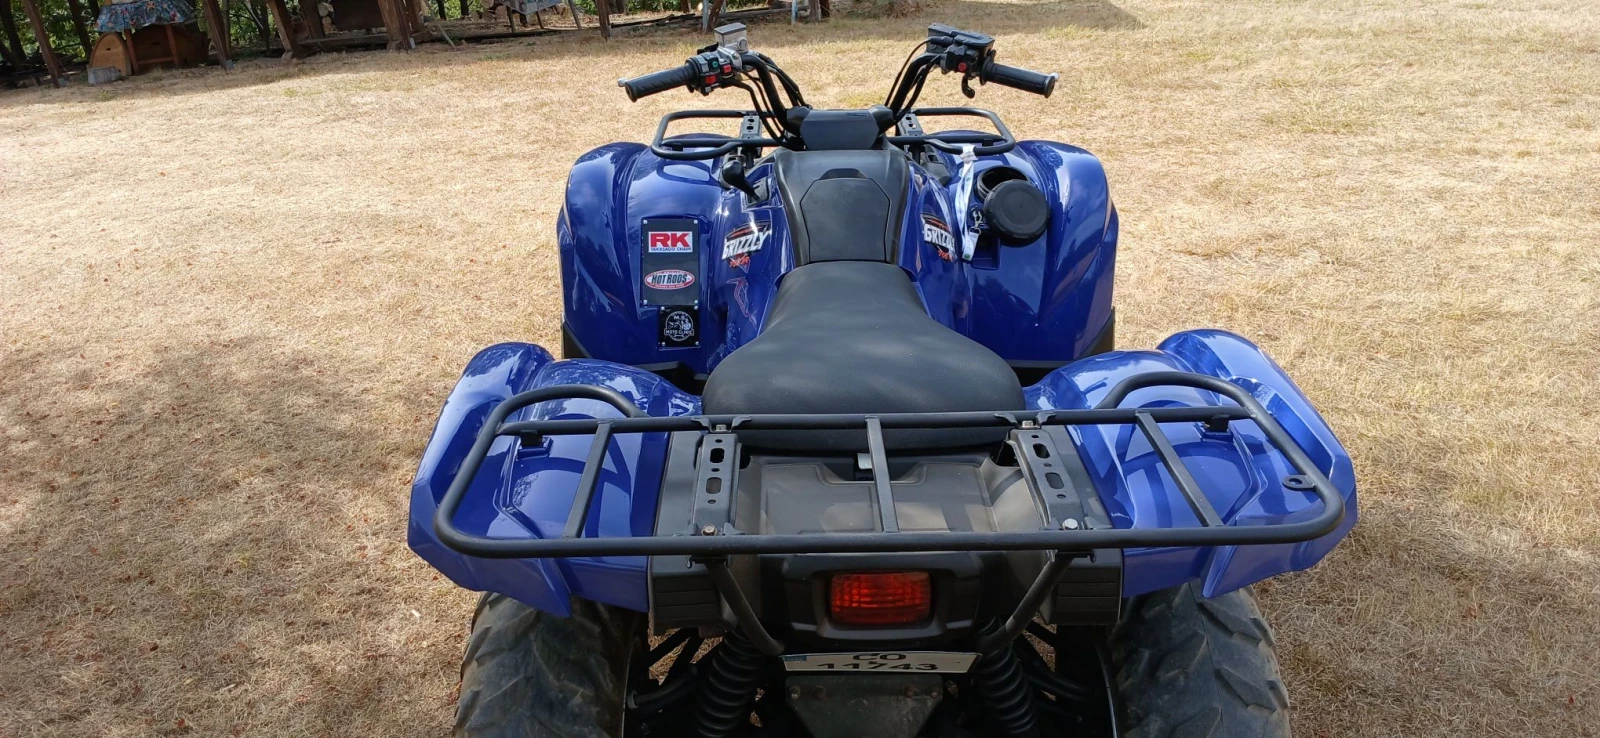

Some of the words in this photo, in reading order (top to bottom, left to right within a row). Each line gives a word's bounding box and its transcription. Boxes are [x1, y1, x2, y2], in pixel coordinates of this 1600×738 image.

[650, 232, 690, 247] RK
[722, 229, 771, 260] GRIZZLY
[651, 274, 666, 285] HOT
[667, 274, 687, 284] RODS
[853, 653, 906, 661] CO
[816, 662, 938, 671] 11743
